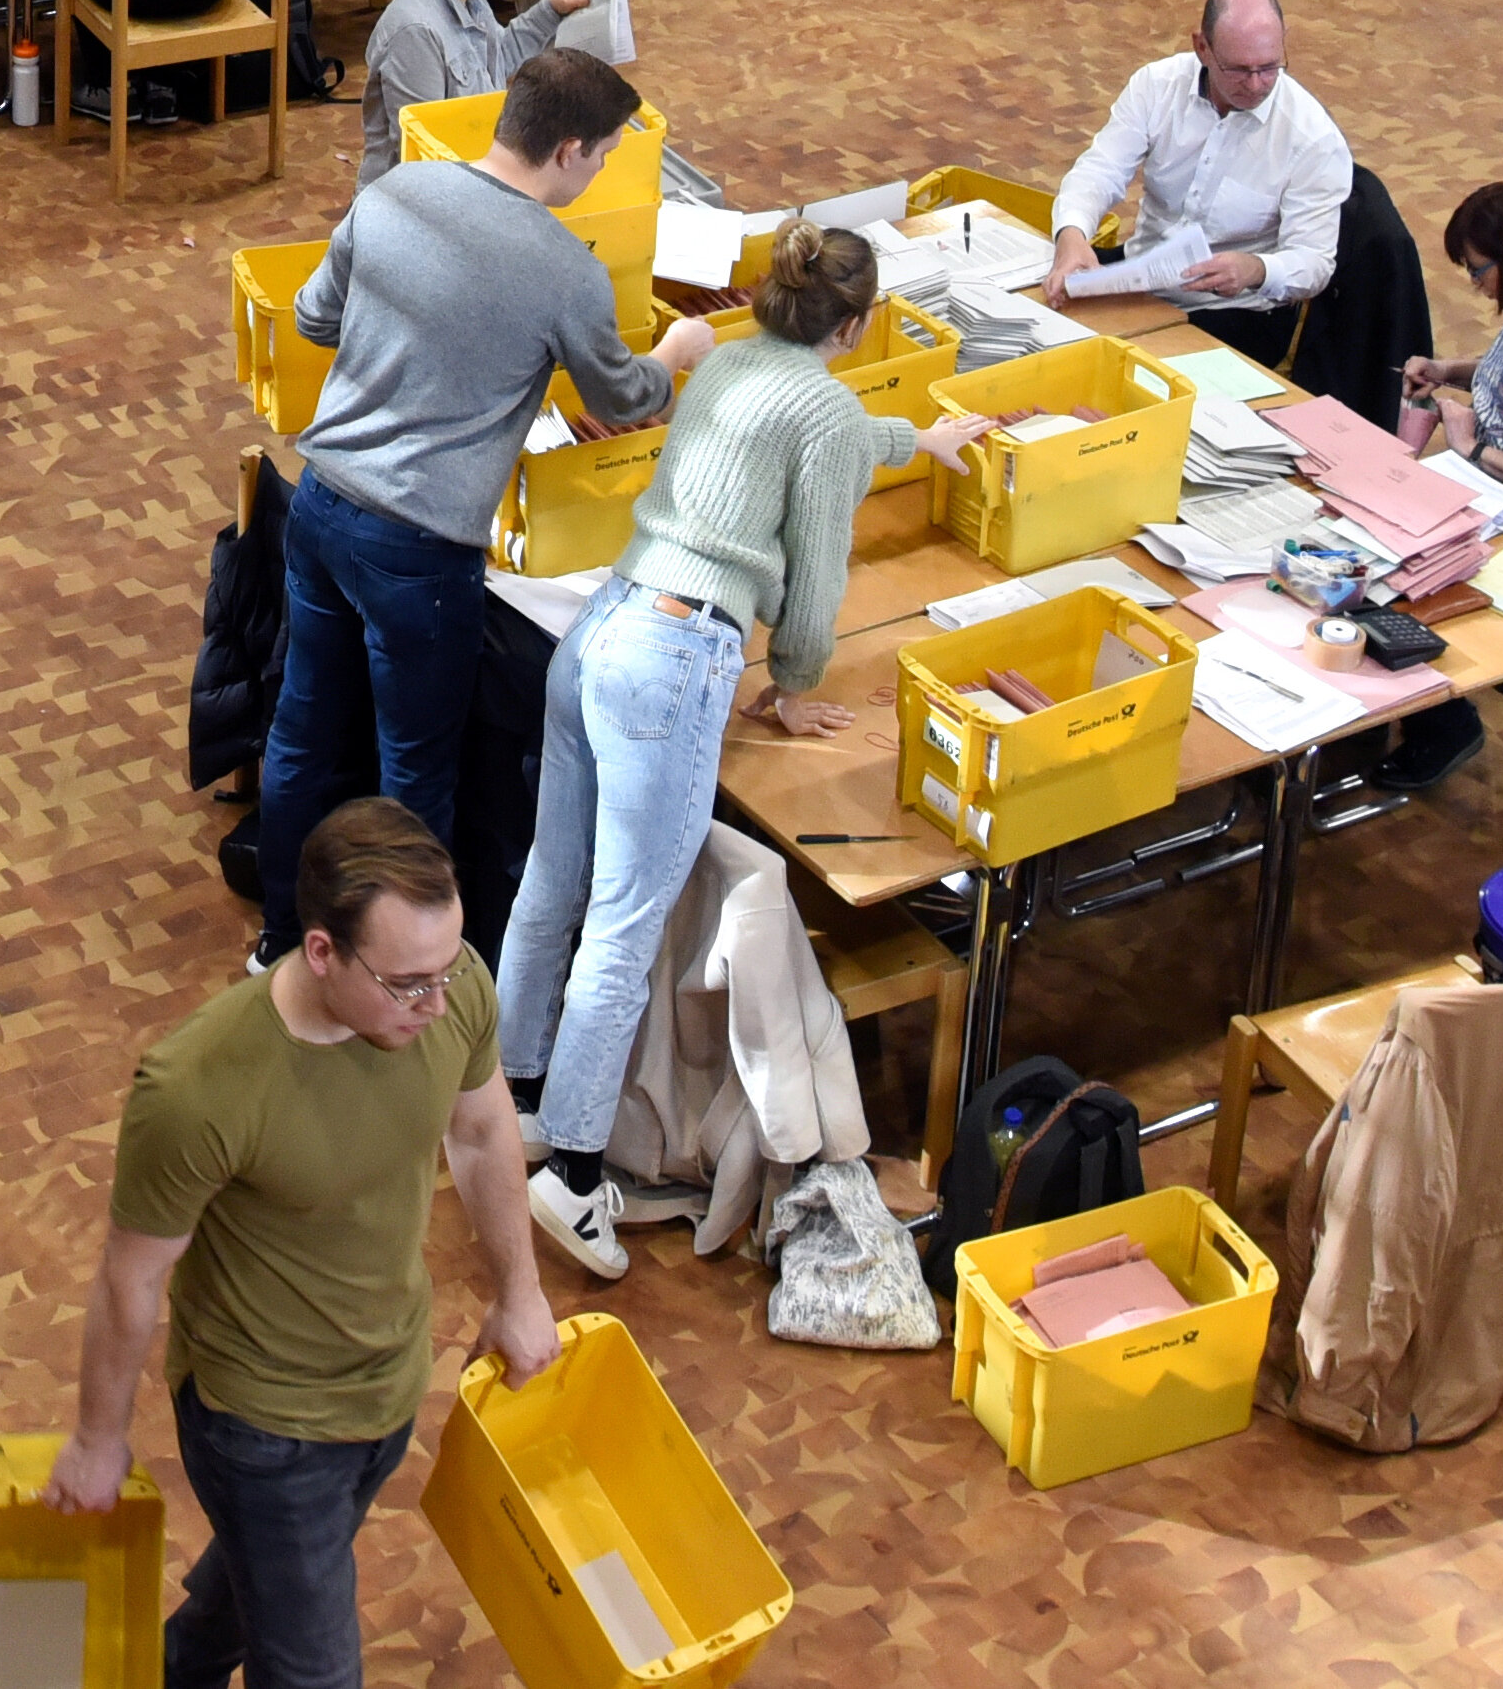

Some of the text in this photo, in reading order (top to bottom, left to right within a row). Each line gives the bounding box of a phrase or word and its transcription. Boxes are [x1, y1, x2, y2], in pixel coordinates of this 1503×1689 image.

[856, 387, 870, 398] sche
[1078, 437, 1123, 457] Deutsche Post
[595, 454, 648, 471] Deutsche Post
[1067, 713, 1119, 738] Deutsche Post
[1122, 1338, 1180, 1361] Deutsche Post
